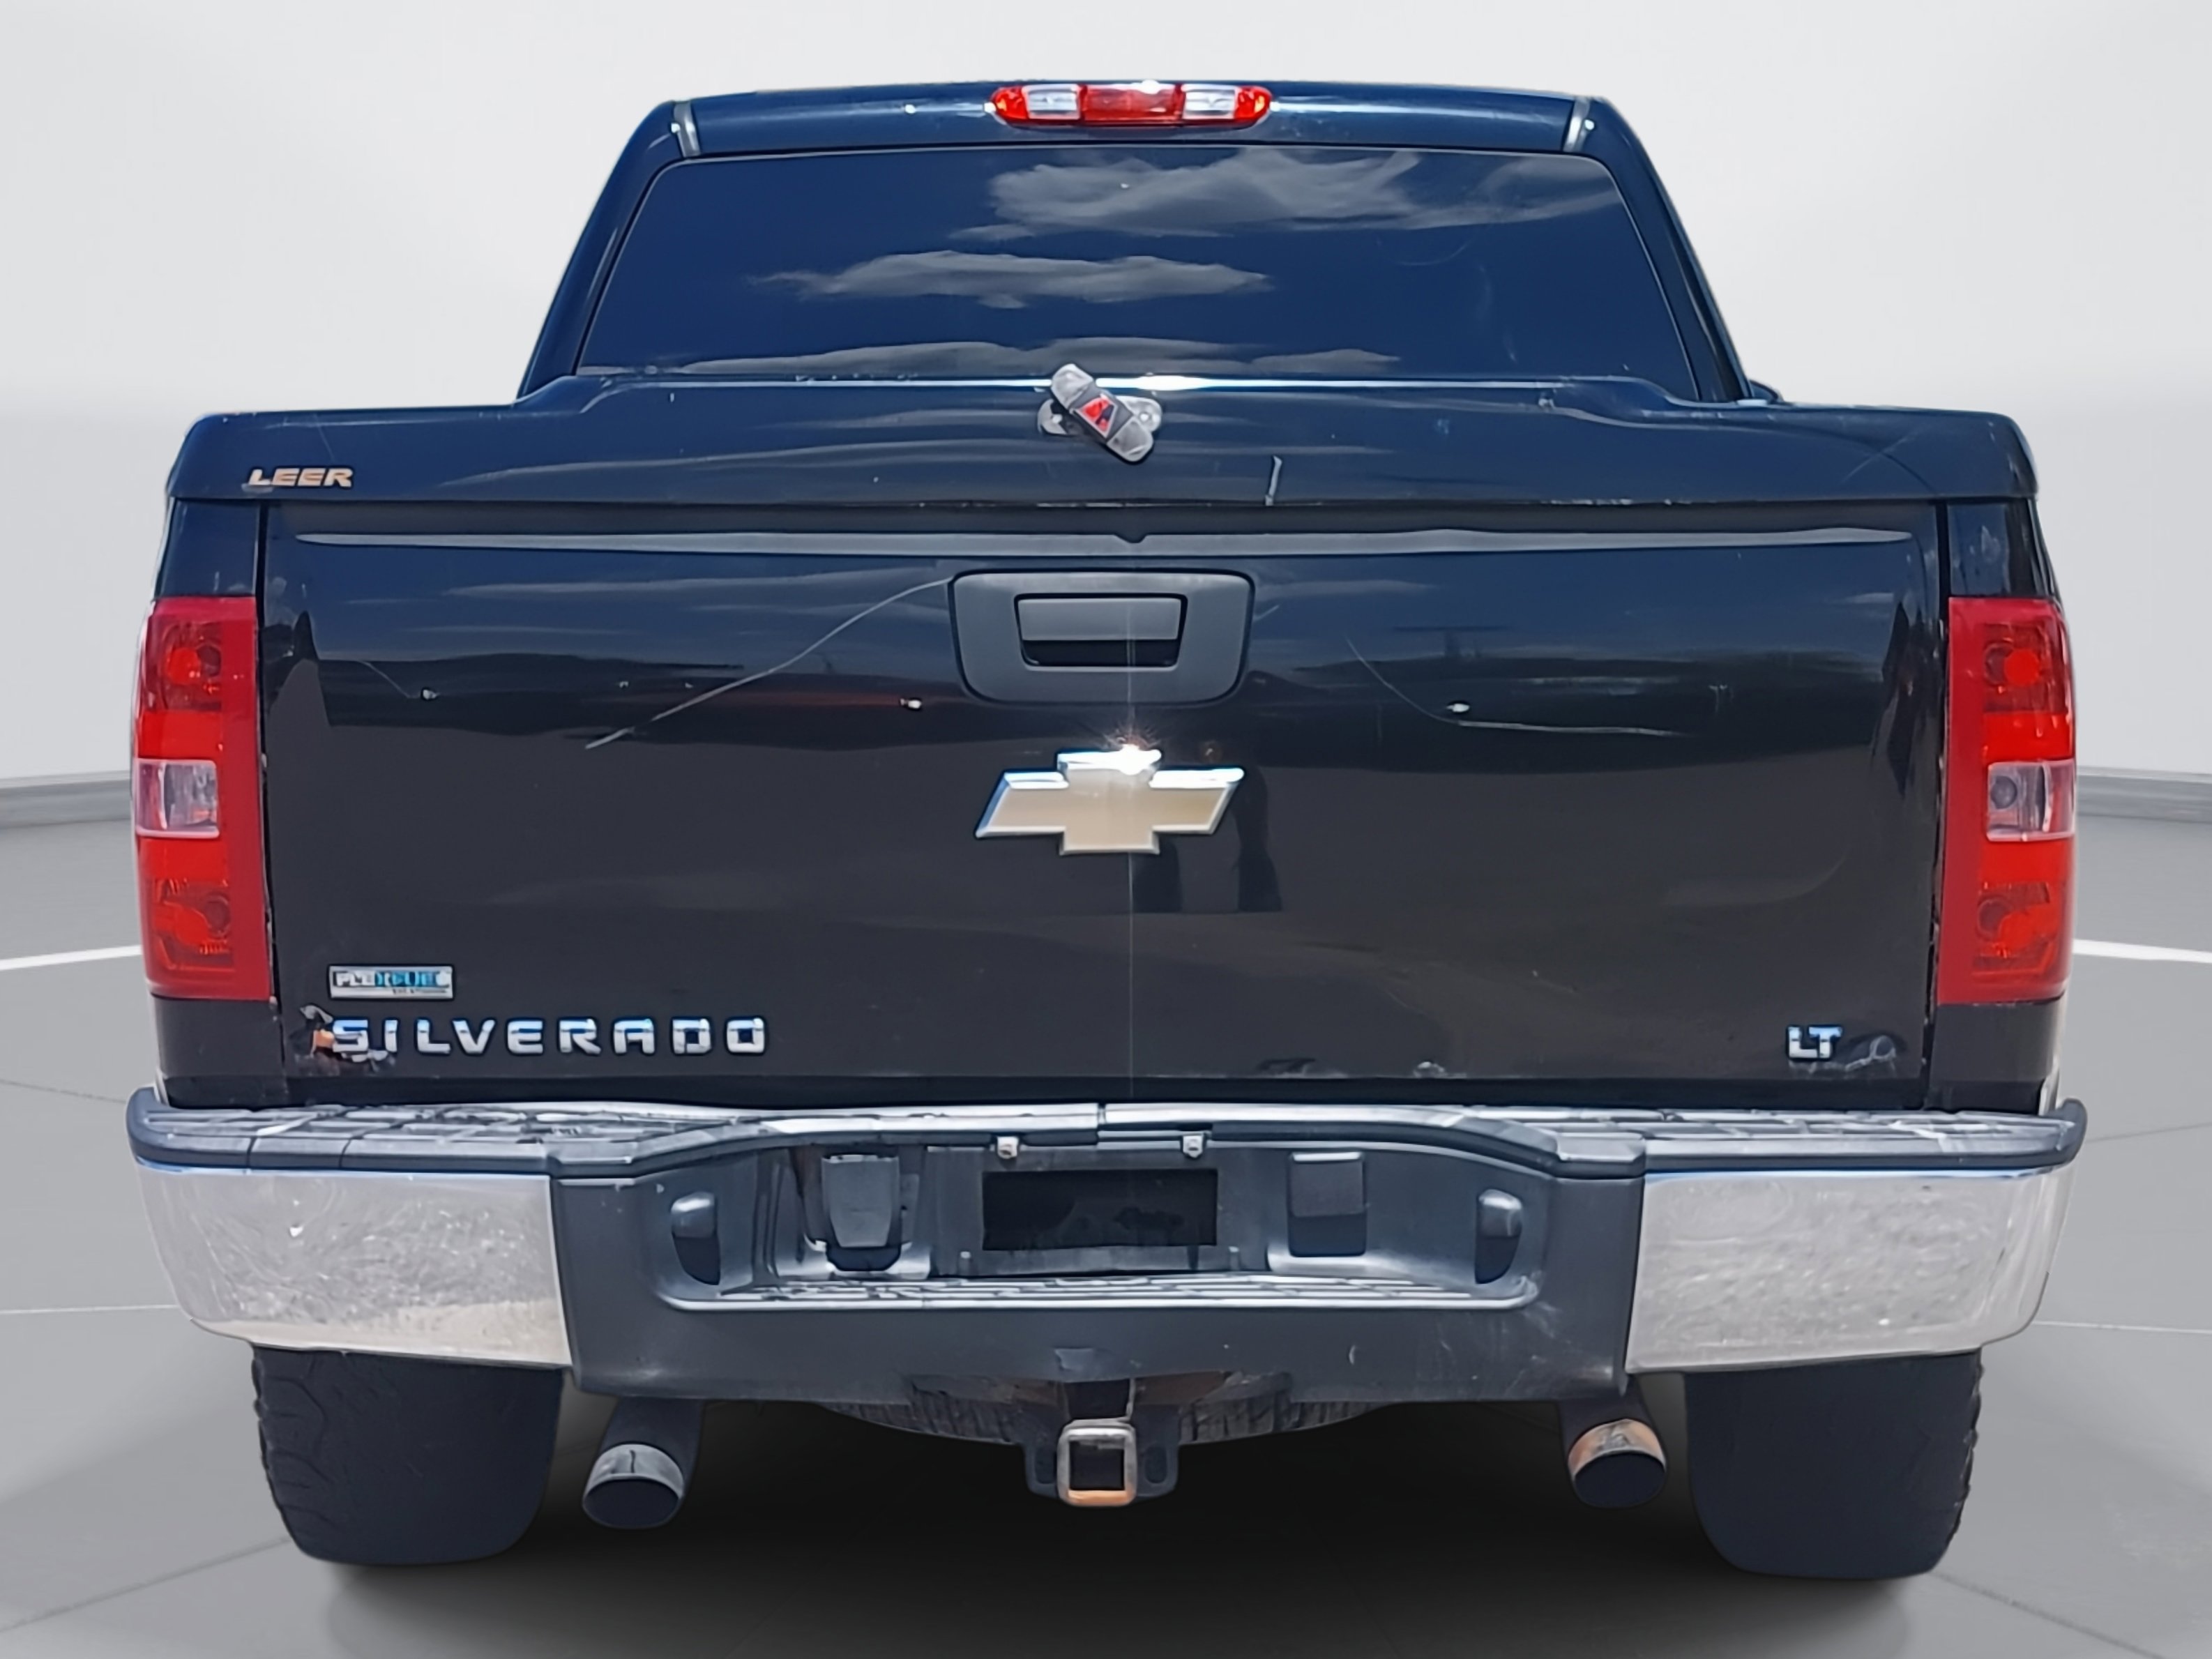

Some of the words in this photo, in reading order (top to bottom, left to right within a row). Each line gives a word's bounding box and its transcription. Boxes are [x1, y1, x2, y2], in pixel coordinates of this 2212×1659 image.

[248, 468, 354, 487] LEER
[332, 1018, 766, 1054] SILVERADO
[1788, 1026, 1842, 1059] LT
